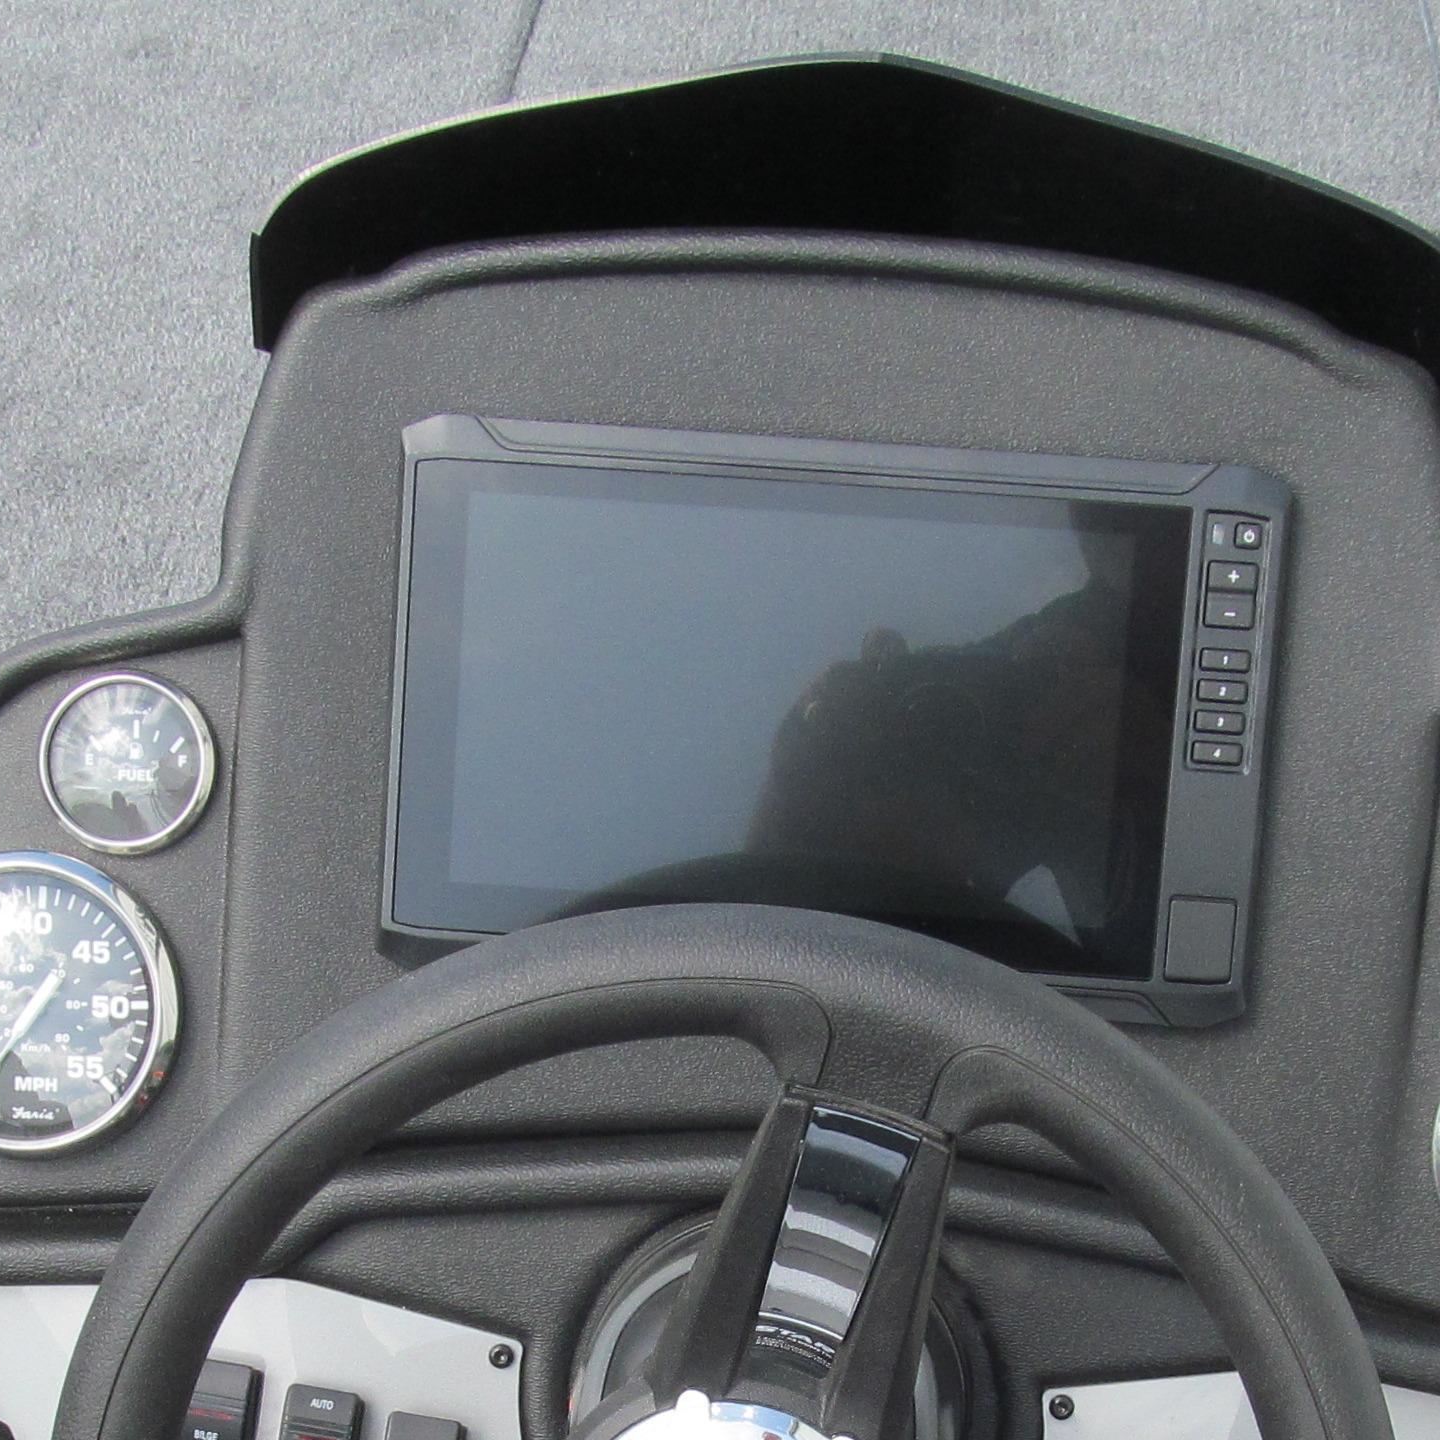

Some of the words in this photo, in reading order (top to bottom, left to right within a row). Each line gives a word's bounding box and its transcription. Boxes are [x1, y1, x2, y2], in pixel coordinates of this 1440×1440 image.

[85, 753, 94, 766] E
[177, 755, 187, 768] F
[117, 769, 154, 782] FUEL
[16, 911, 53, 936] 40
[71, 940, 111, 965] 45
[91, 995, 130, 1019] 50
[67, 1055, 104, 1079] 55
[14, 1076, 58, 1092] MPH
[310, 1398, 334, 1411] AUTO
